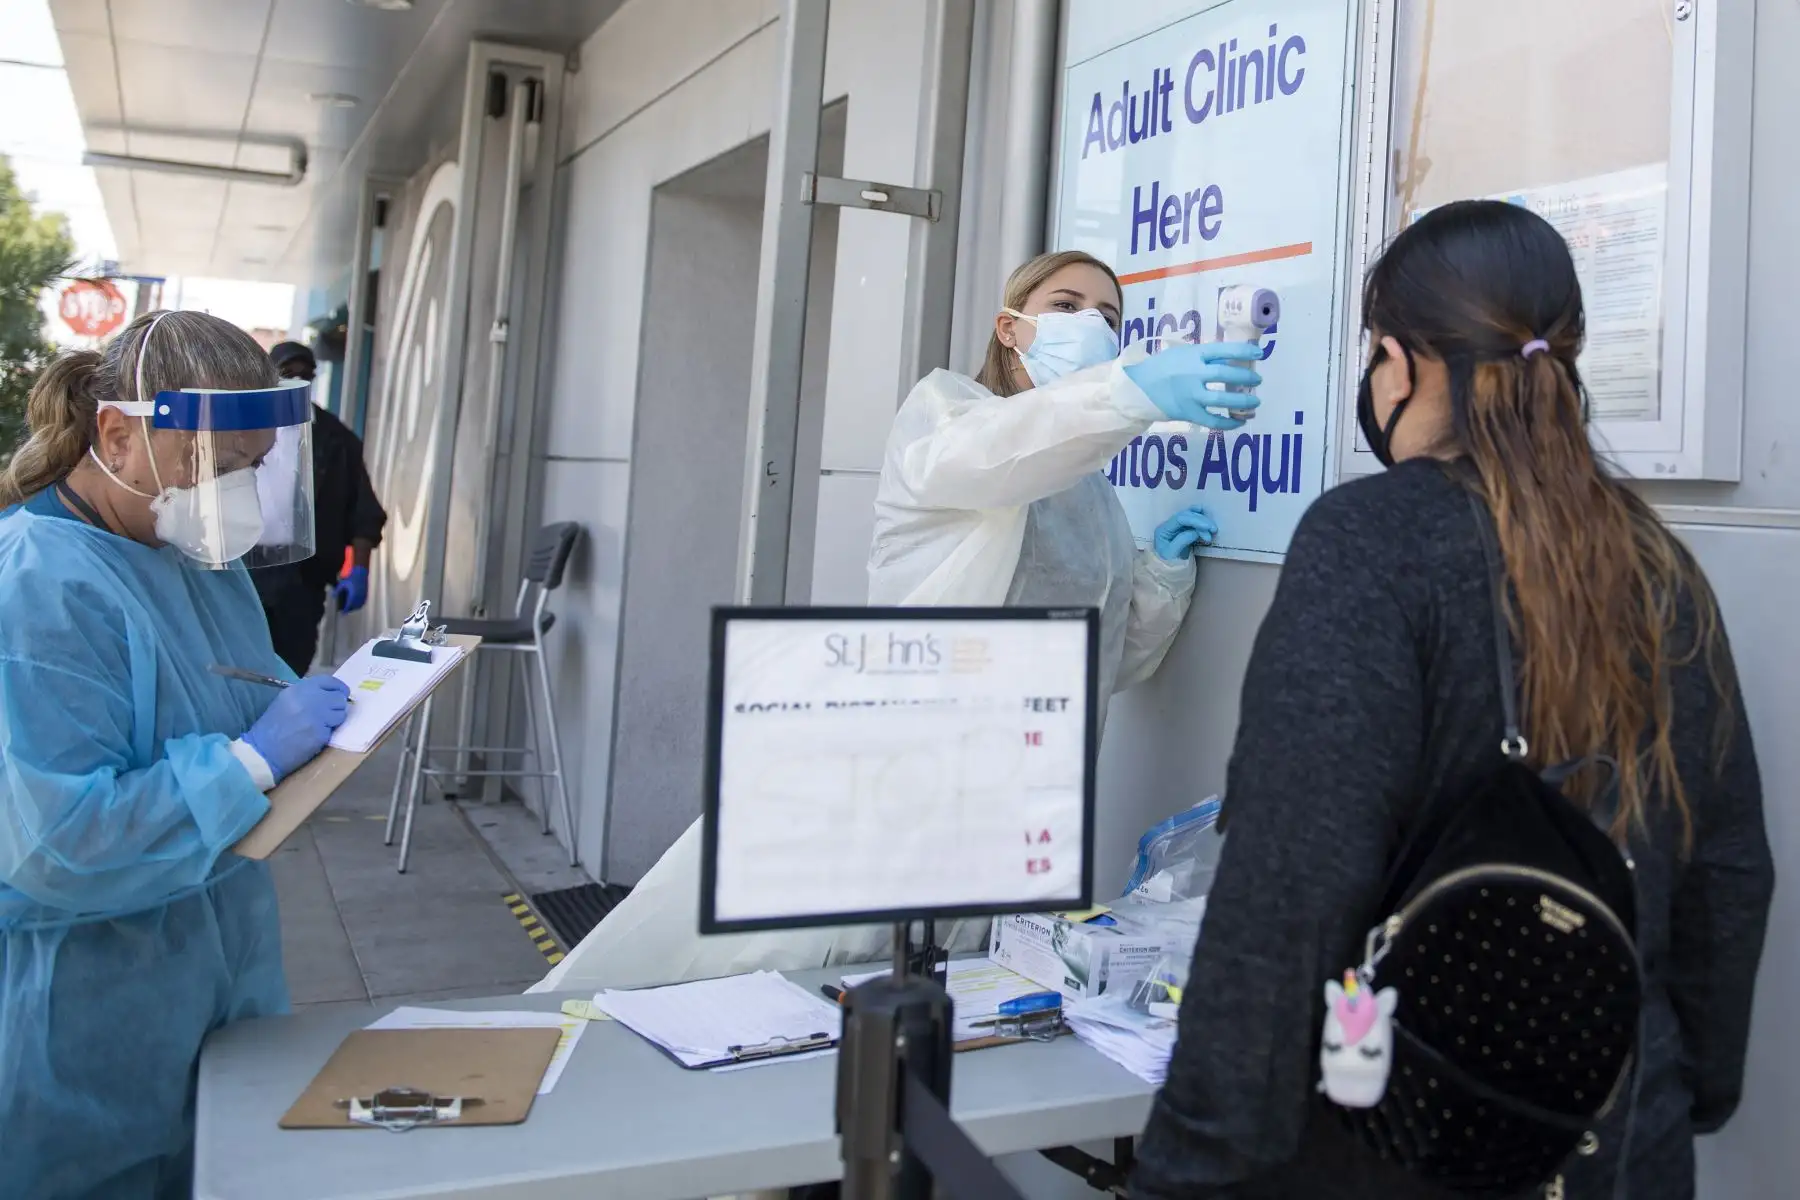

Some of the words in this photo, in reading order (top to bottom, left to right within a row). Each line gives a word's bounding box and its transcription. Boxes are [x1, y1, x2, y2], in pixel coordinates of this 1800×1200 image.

[1081, 67, 1175, 160] Adult
[1184, 23, 1306, 124] Clinic
[1130, 181, 1224, 256] Here
[1196, 411, 1304, 512] Aqui
[1015, 914, 1051, 936] CRITERION
